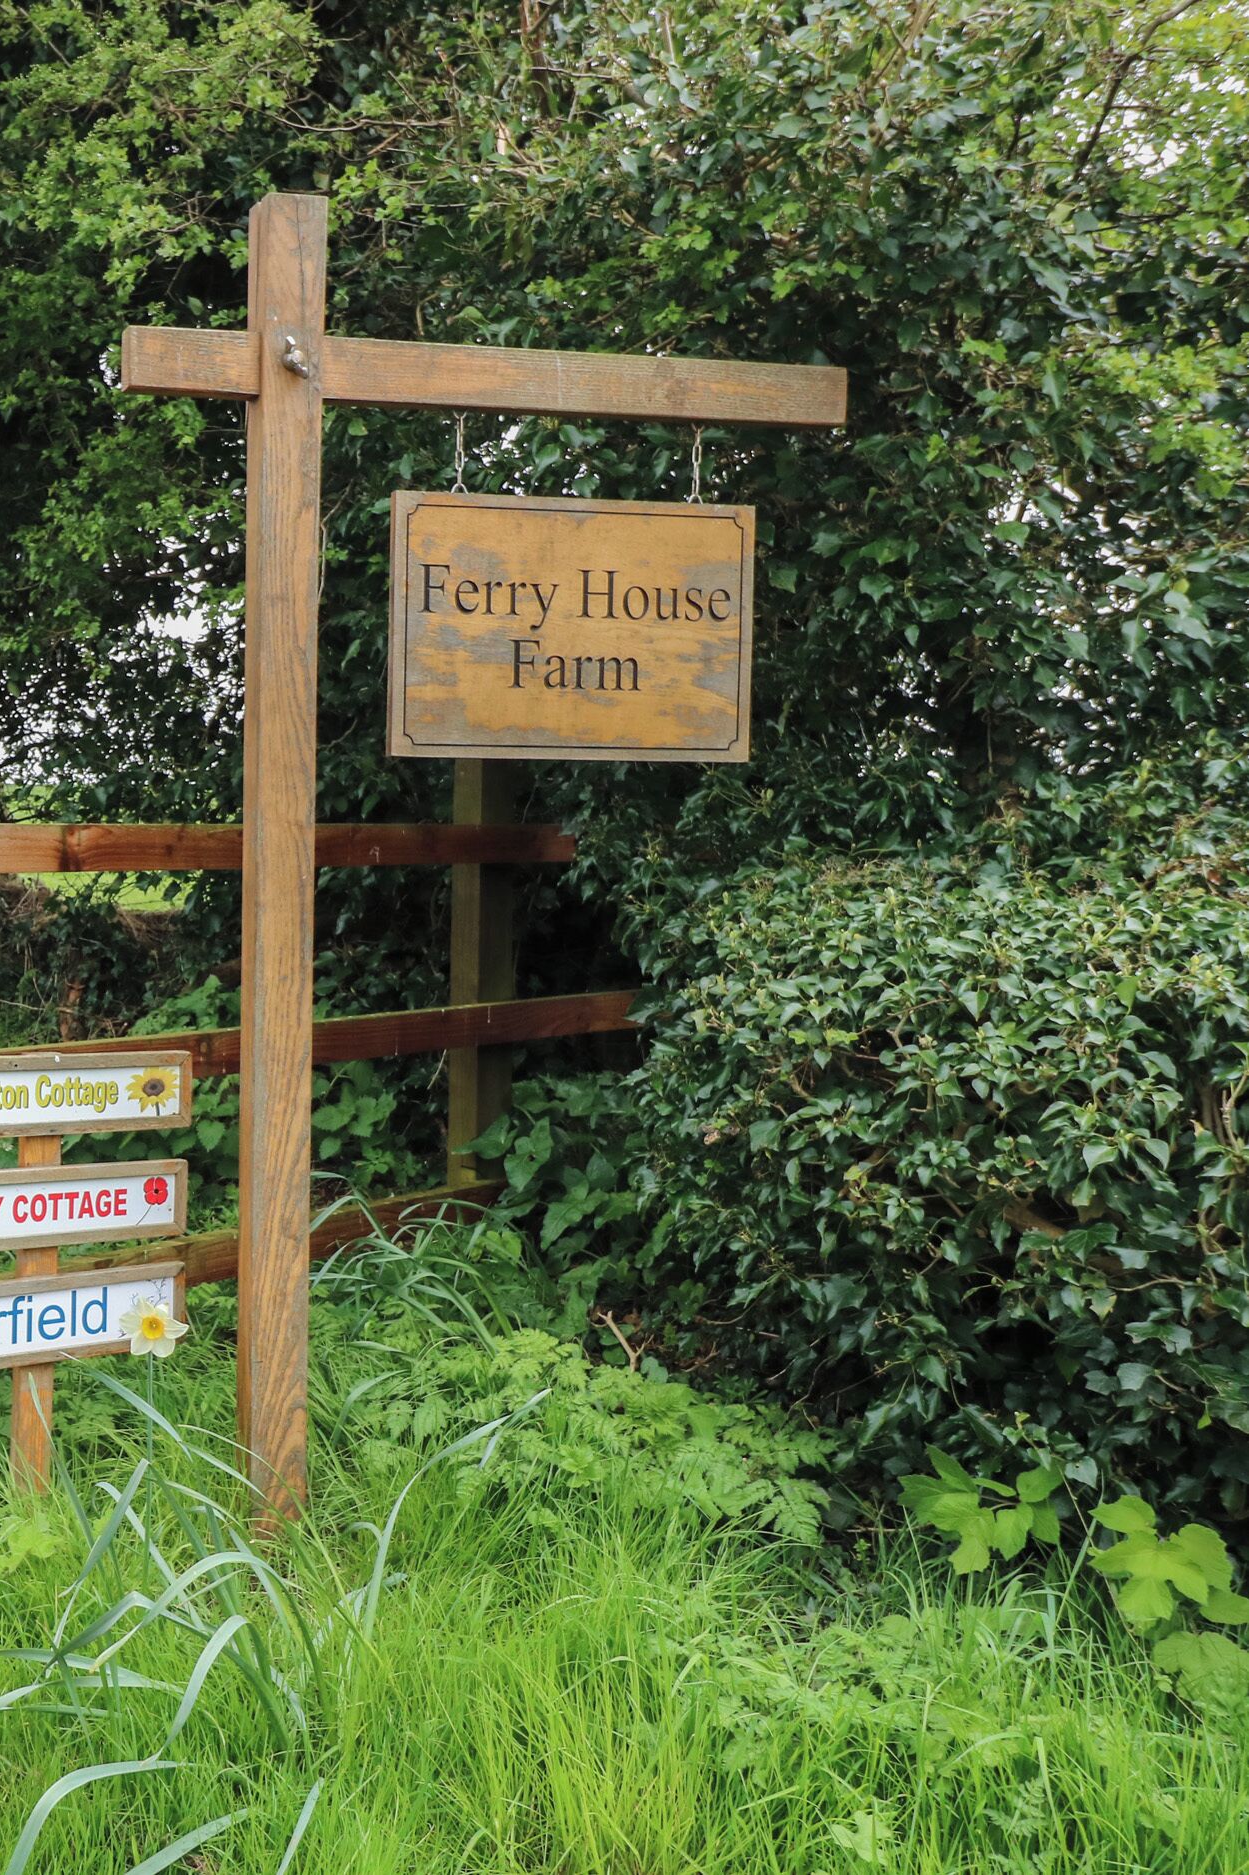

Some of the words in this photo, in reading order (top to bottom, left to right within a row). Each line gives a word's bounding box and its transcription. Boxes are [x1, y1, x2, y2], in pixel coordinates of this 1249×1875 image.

[417, 564, 559, 630] Ferry
[577, 569, 731, 622] House
[508, 639, 641, 691] Farm
[35, 1074, 119, 1113] Cottage
[12, 1188, 128, 1223] COTTAGE
